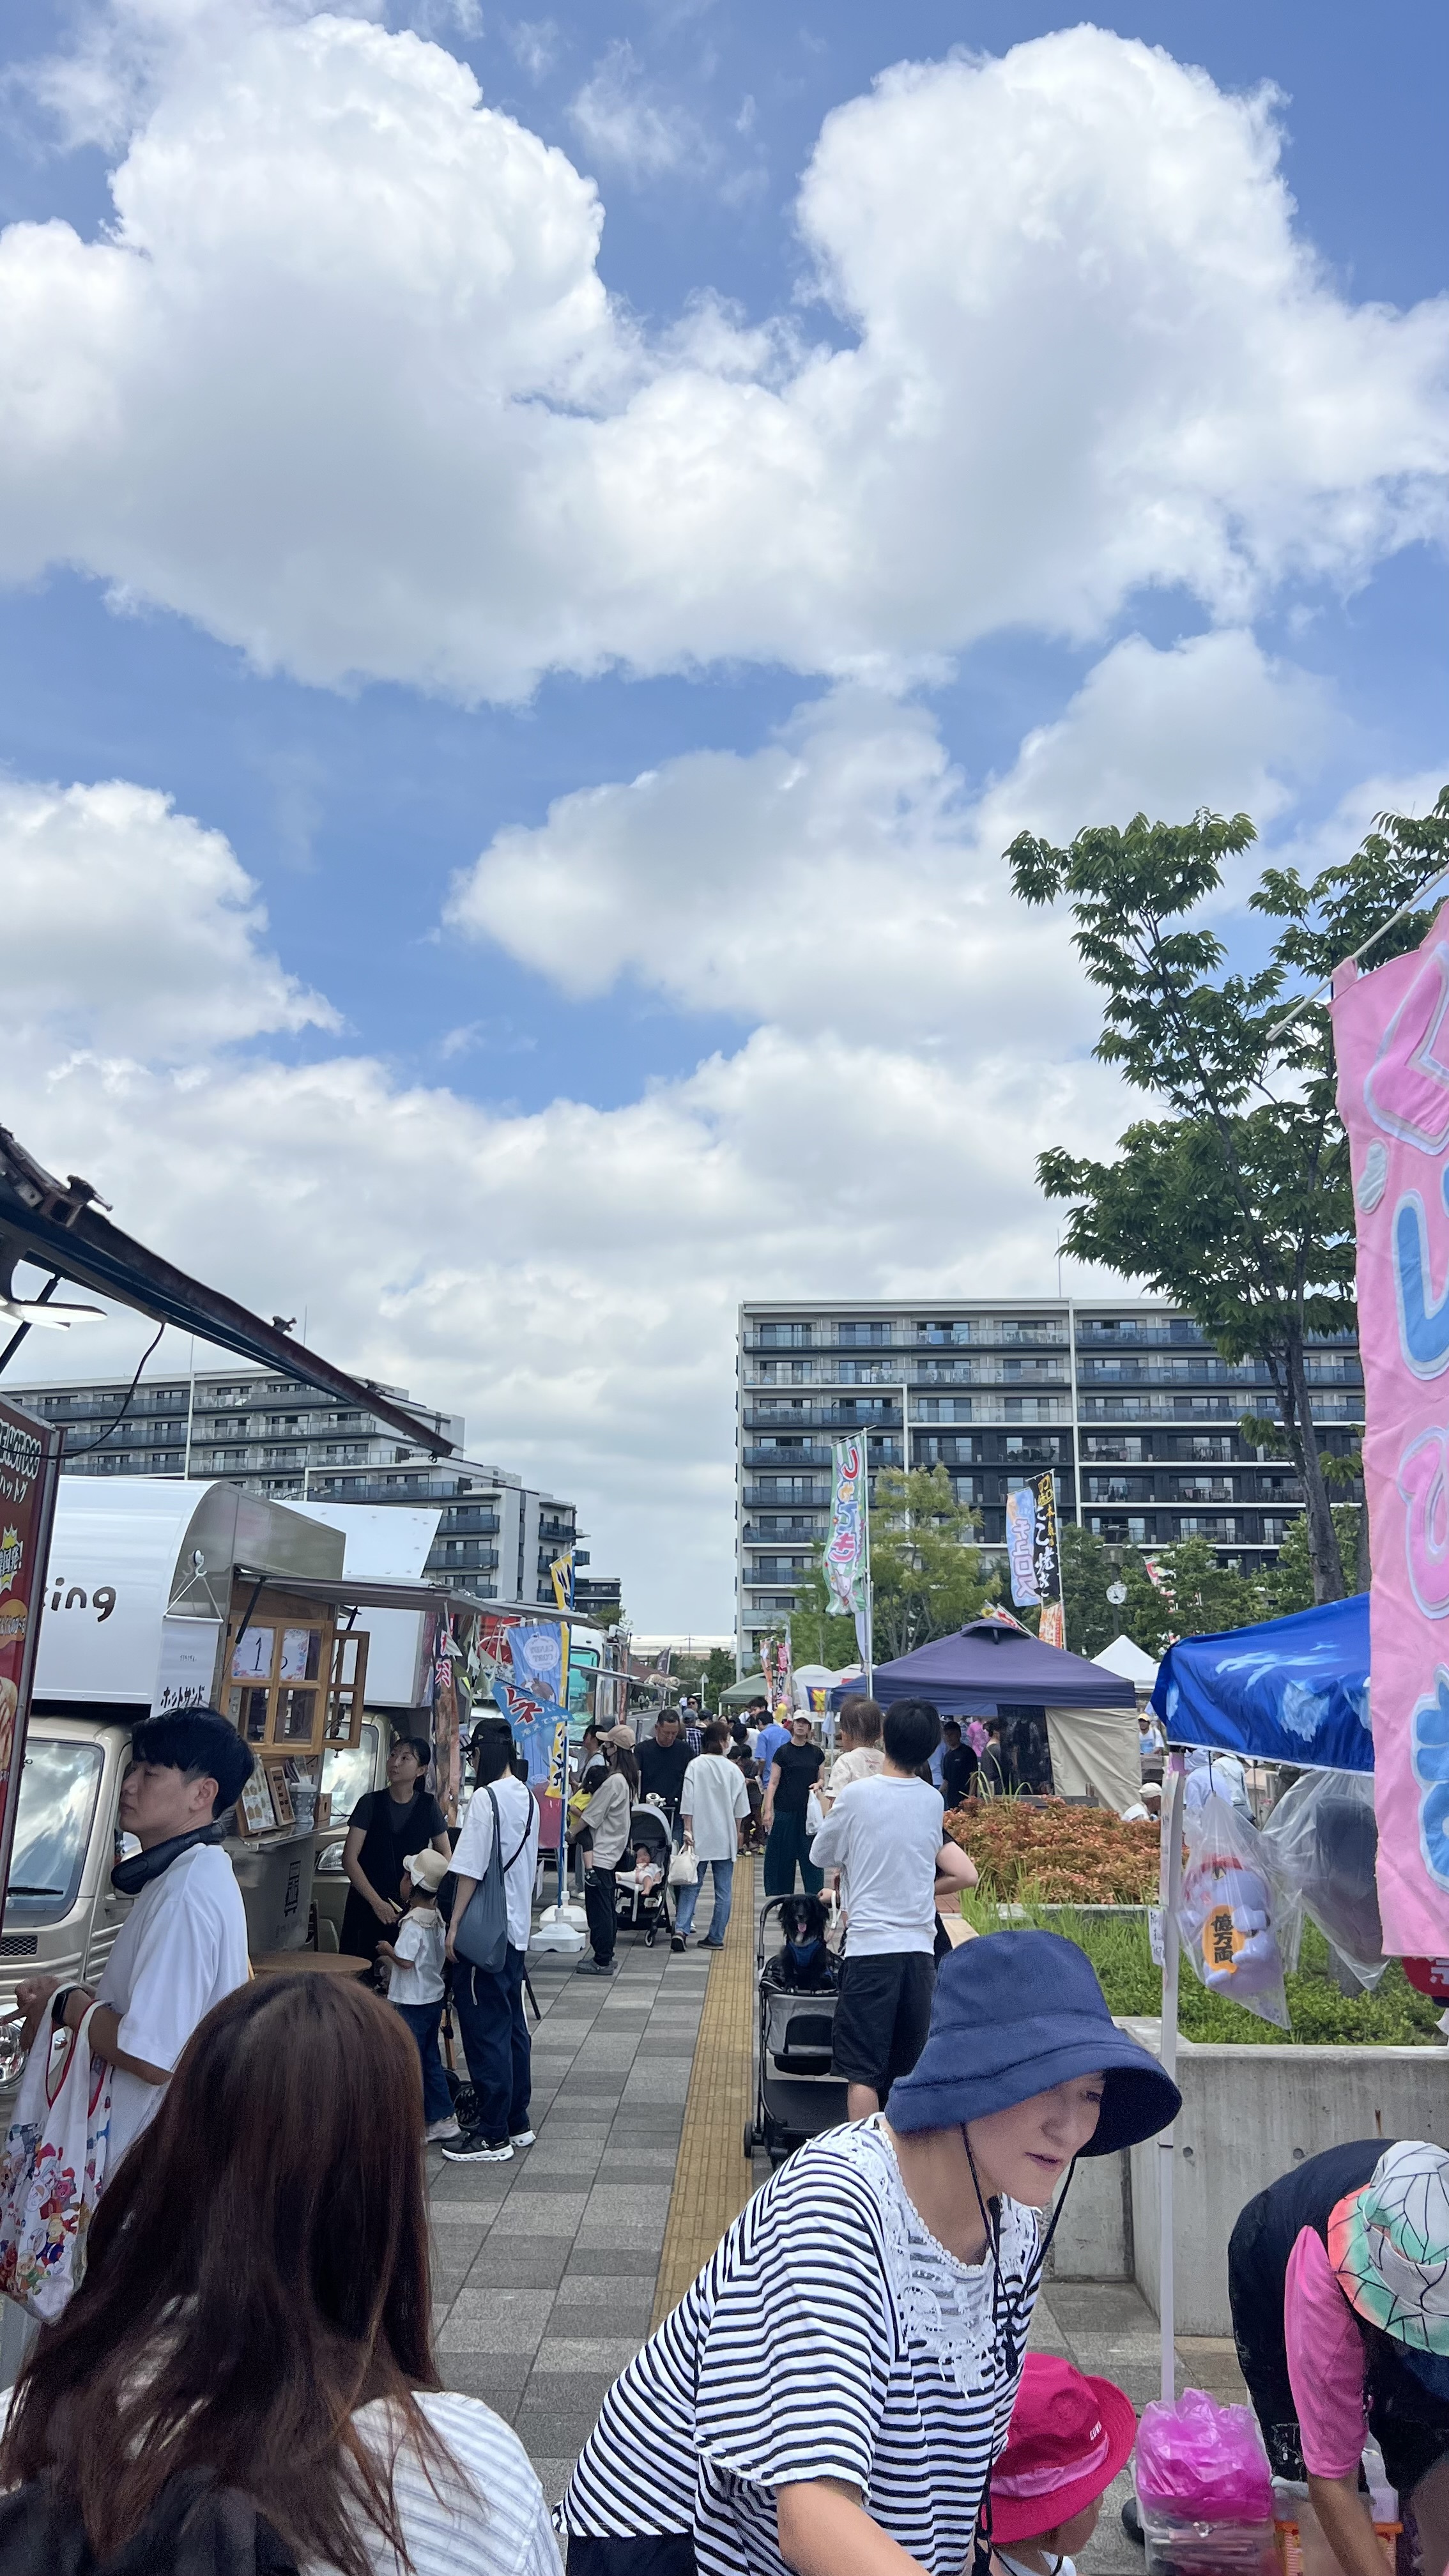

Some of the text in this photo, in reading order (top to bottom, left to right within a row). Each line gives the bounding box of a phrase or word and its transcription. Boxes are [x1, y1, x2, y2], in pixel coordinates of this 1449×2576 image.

[0, 1473, 28, 1504] ハットグ
[43, 1577, 116, 1622] ing
